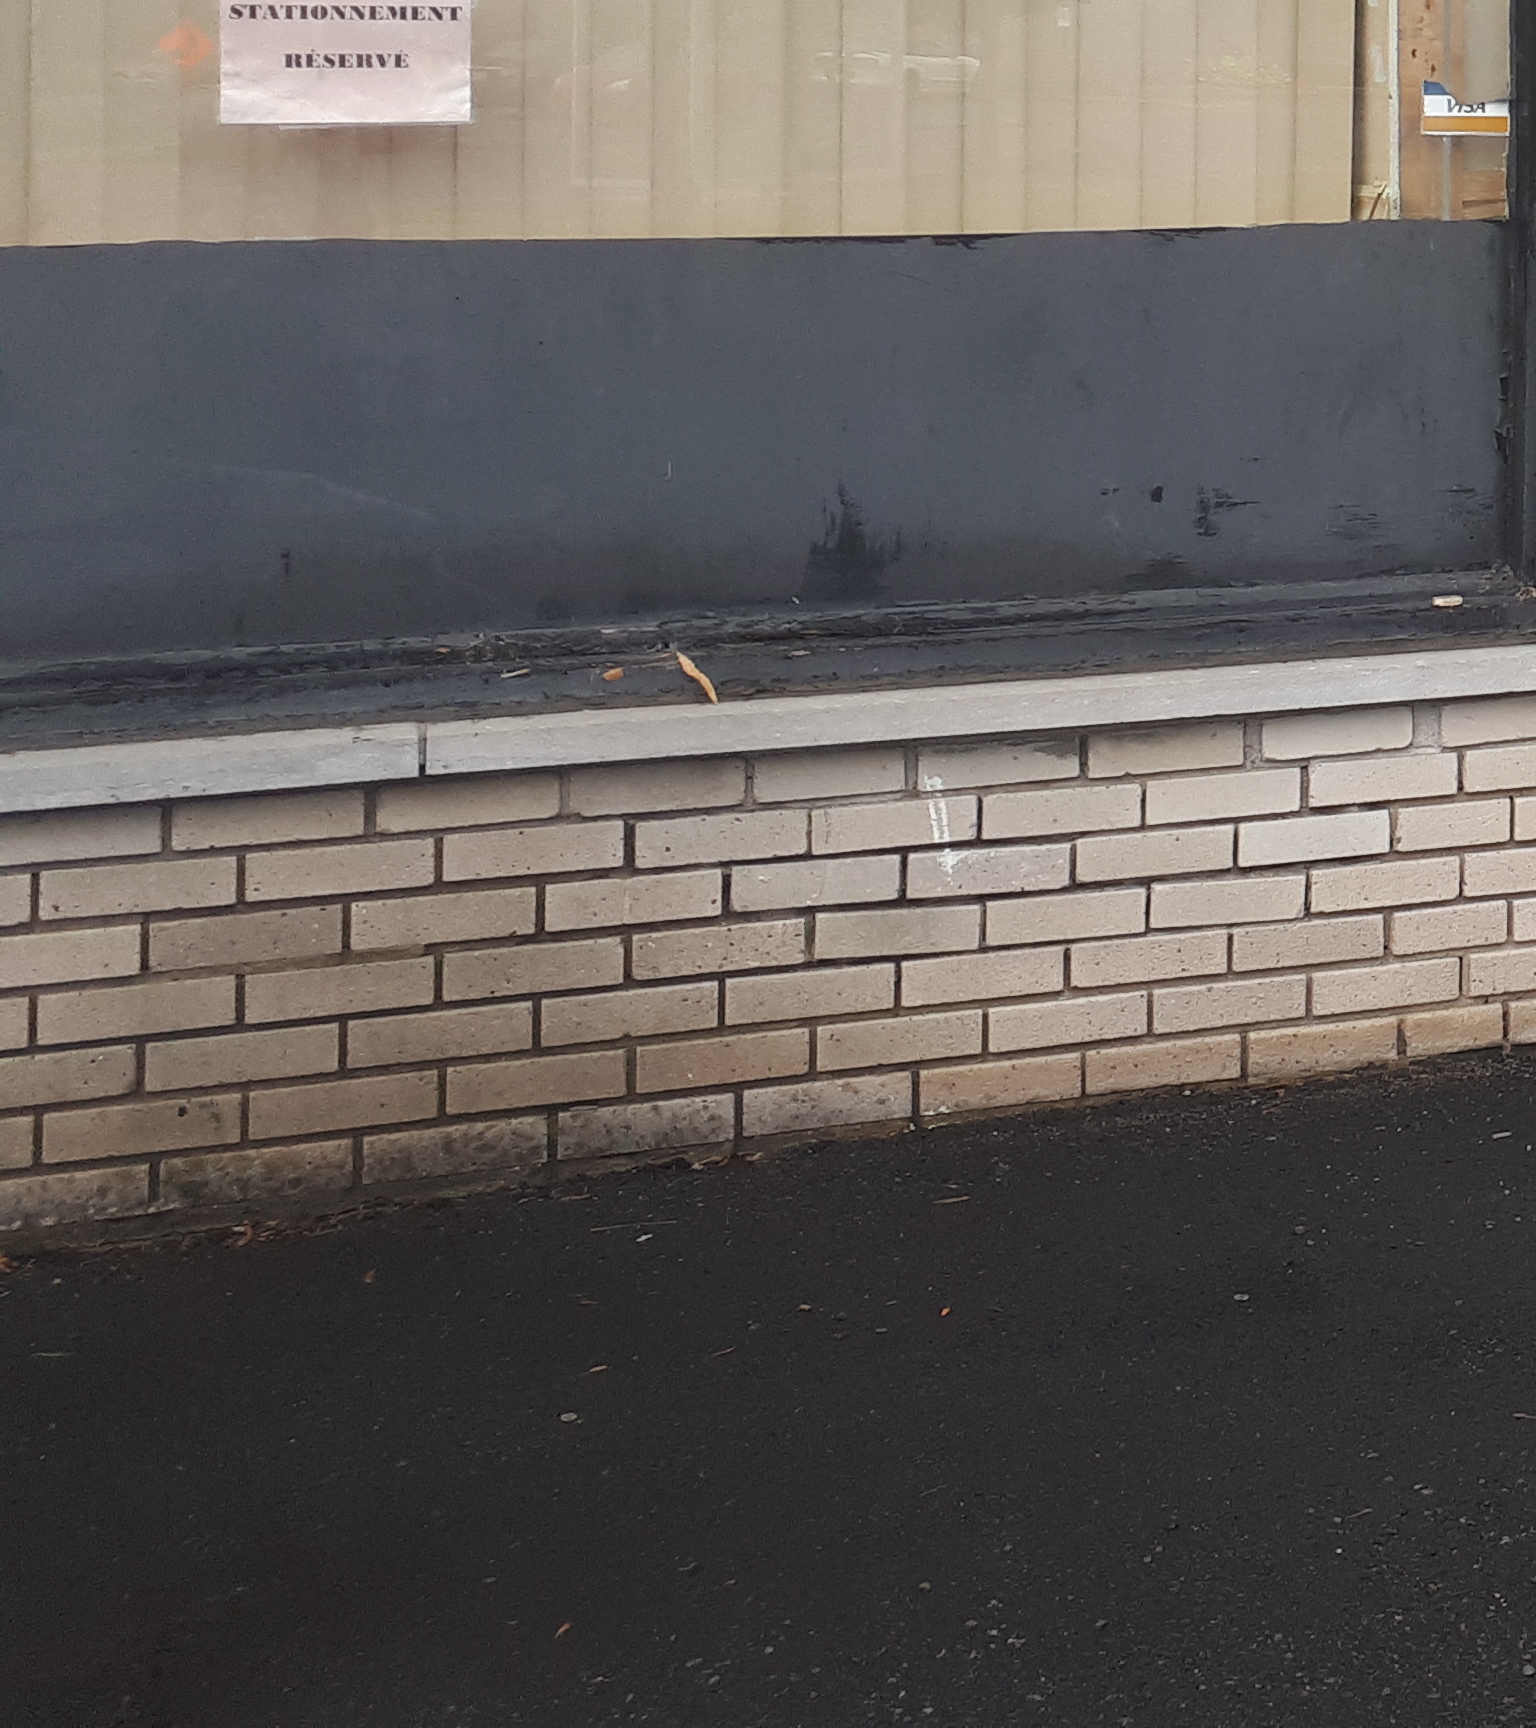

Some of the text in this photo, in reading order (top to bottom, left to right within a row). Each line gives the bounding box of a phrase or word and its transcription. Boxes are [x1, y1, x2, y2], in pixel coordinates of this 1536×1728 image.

[228, 3, 462, 21] STATIONNEMENT
[282, 48, 410, 69] RÉSERVÉ
[1446, 98, 1486, 114] VISA
